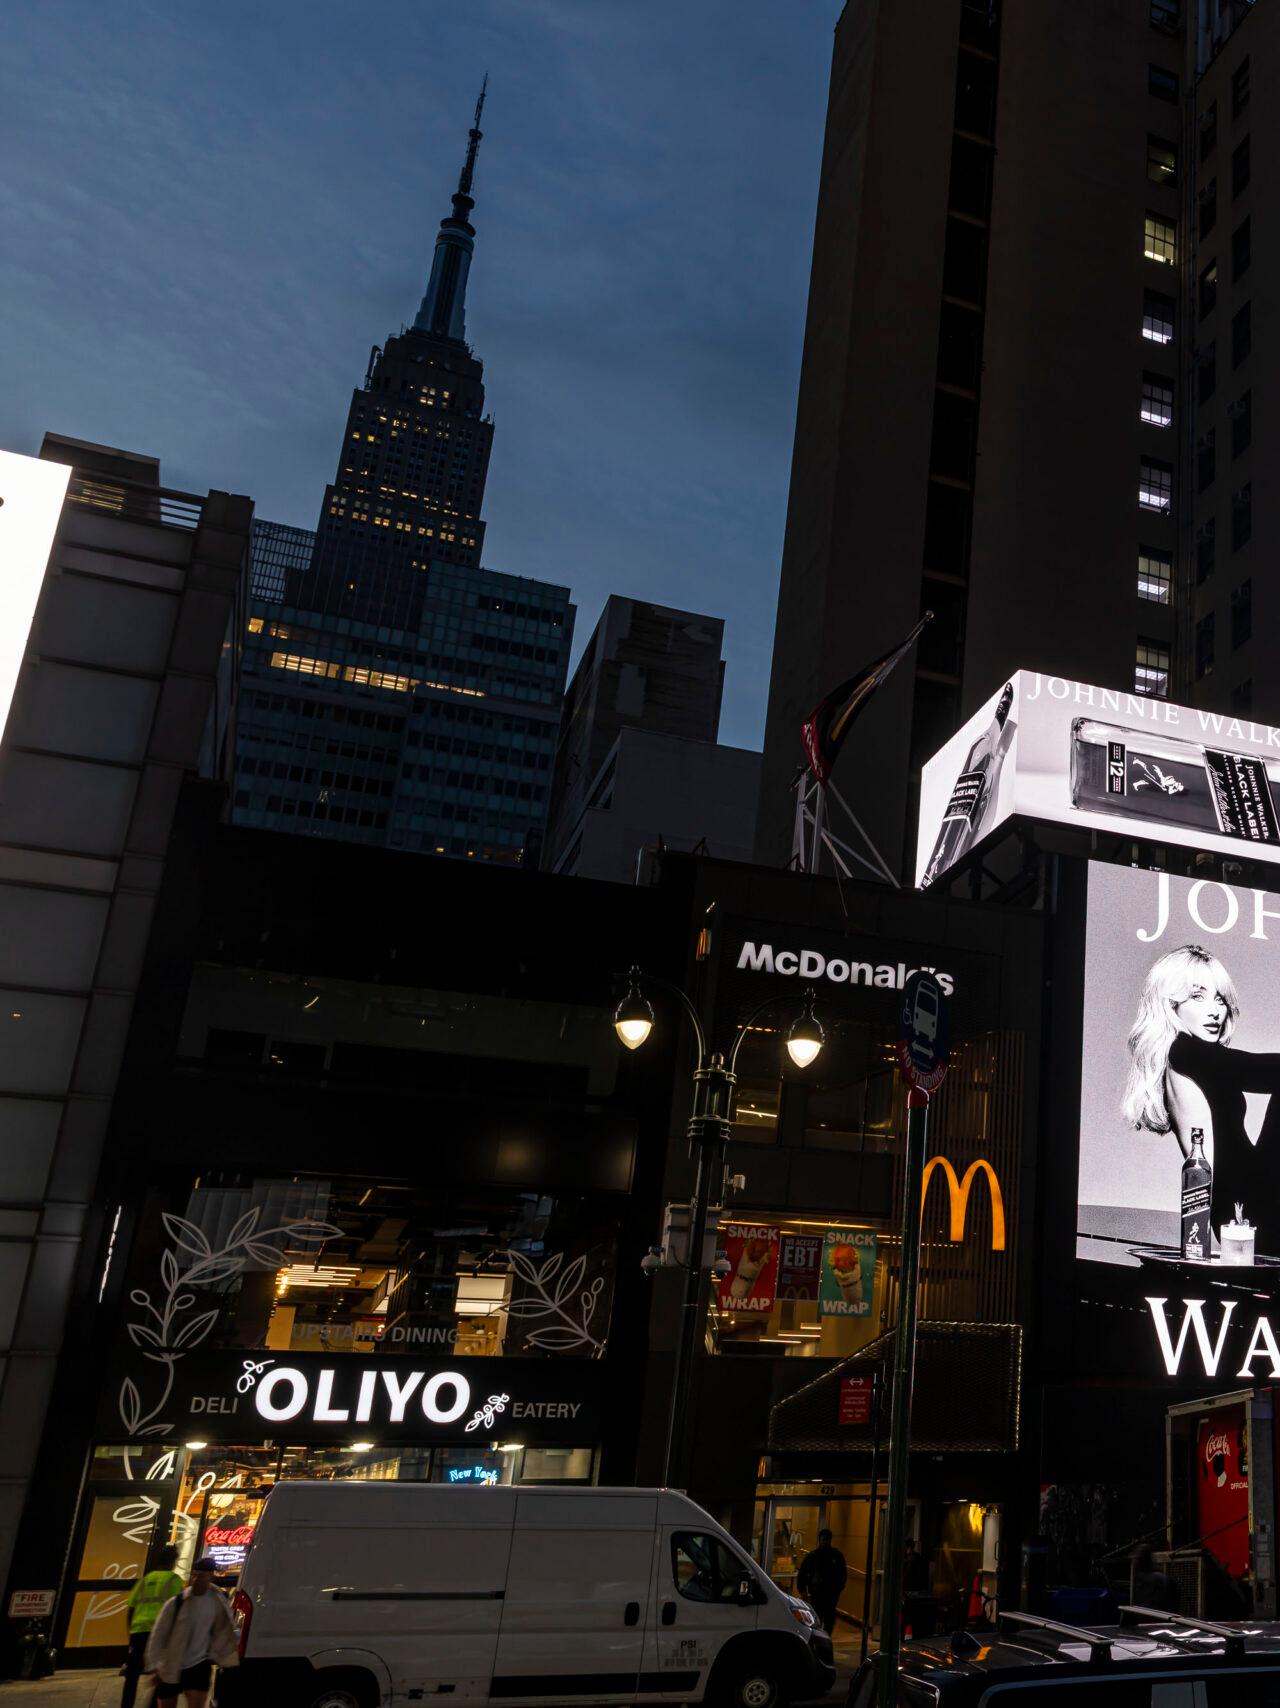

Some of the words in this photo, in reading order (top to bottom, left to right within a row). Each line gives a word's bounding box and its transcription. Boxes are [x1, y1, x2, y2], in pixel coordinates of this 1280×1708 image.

[1027, 672, 1180, 725] JOHNNIE
[1110, 760, 1124, 777] 12
[1233, 756, 1250, 799] BLACK
[728, 1225, 778, 1240] SNACK
[827, 1231, 875, 1246] SNACK
[784, 1246, 819, 1267] EBT
[722, 1296, 771, 1311] WRAP
[823, 1300, 870, 1314] WRAP
[291, 1323, 387, 1343] UPSTAIRS
[390, 1326, 459, 1344] DINING
[255, 1367, 471, 1423] OLIYO
[190, 1396, 238, 1414] DELI
[512, 1402, 582, 1420] EATERY
[449, 1469, 472, 1481] New
[21, 1593, 46, 1602] FIRE
[680, 1640, 697, 1649] PSI
